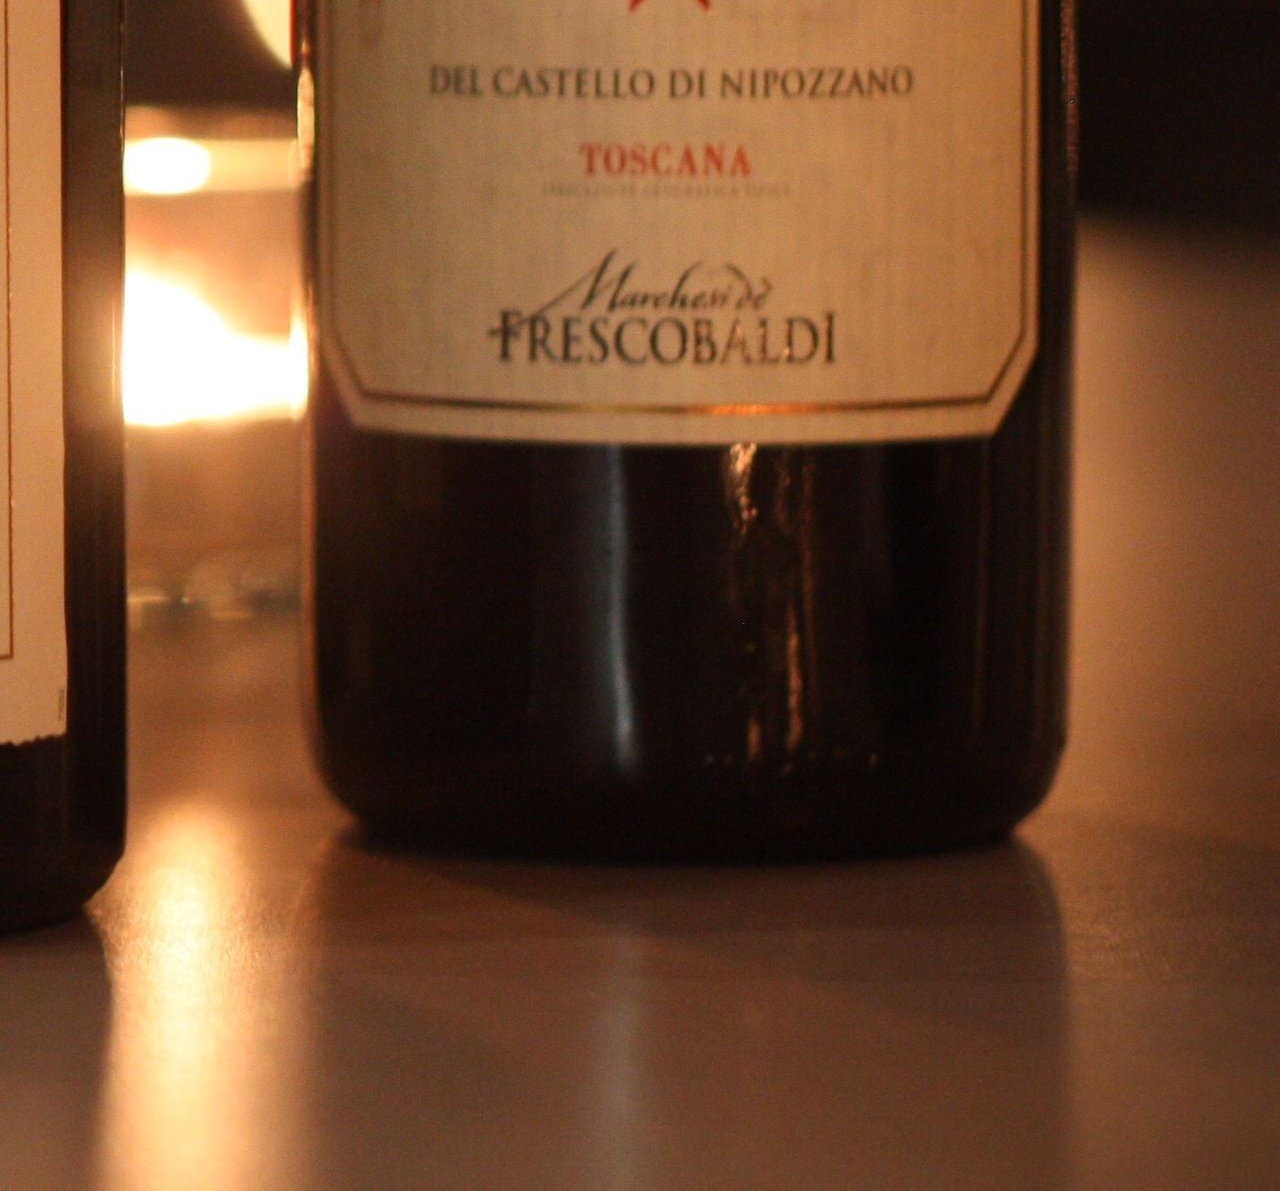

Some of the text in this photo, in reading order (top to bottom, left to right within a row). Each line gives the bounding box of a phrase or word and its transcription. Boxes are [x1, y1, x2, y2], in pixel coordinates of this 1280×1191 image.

[429, 64, 916, 103] DEL CASTELLO DI NIPOZZANO
[578, 141, 753, 178] TOSCANA
[488, 308, 837, 365] FRESCOBALDI
